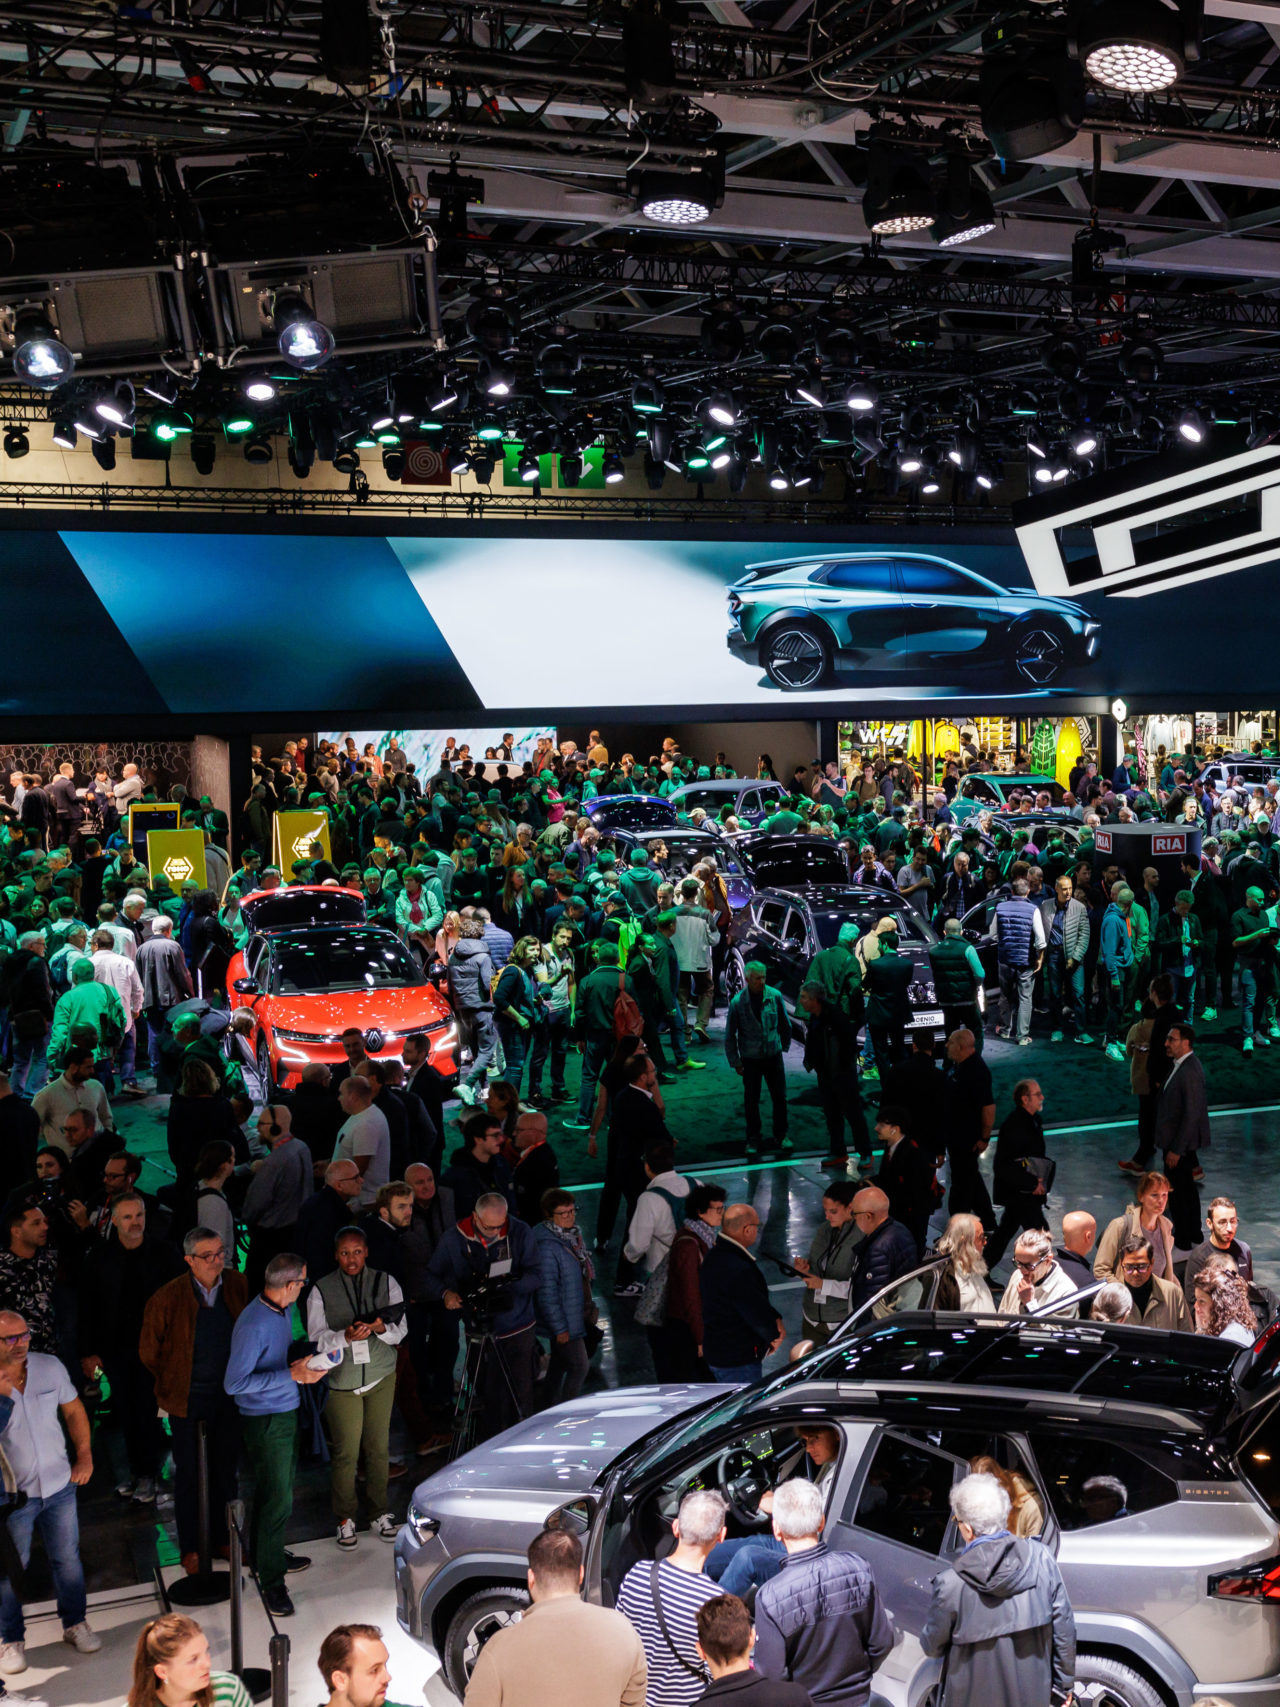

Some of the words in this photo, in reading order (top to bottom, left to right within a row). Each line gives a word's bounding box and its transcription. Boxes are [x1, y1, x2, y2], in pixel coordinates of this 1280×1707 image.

[1097, 833, 1110, 849] RIA
[1156, 838, 1182, 851] RIA
[1185, 1488, 1230, 1496] BIGSTER
